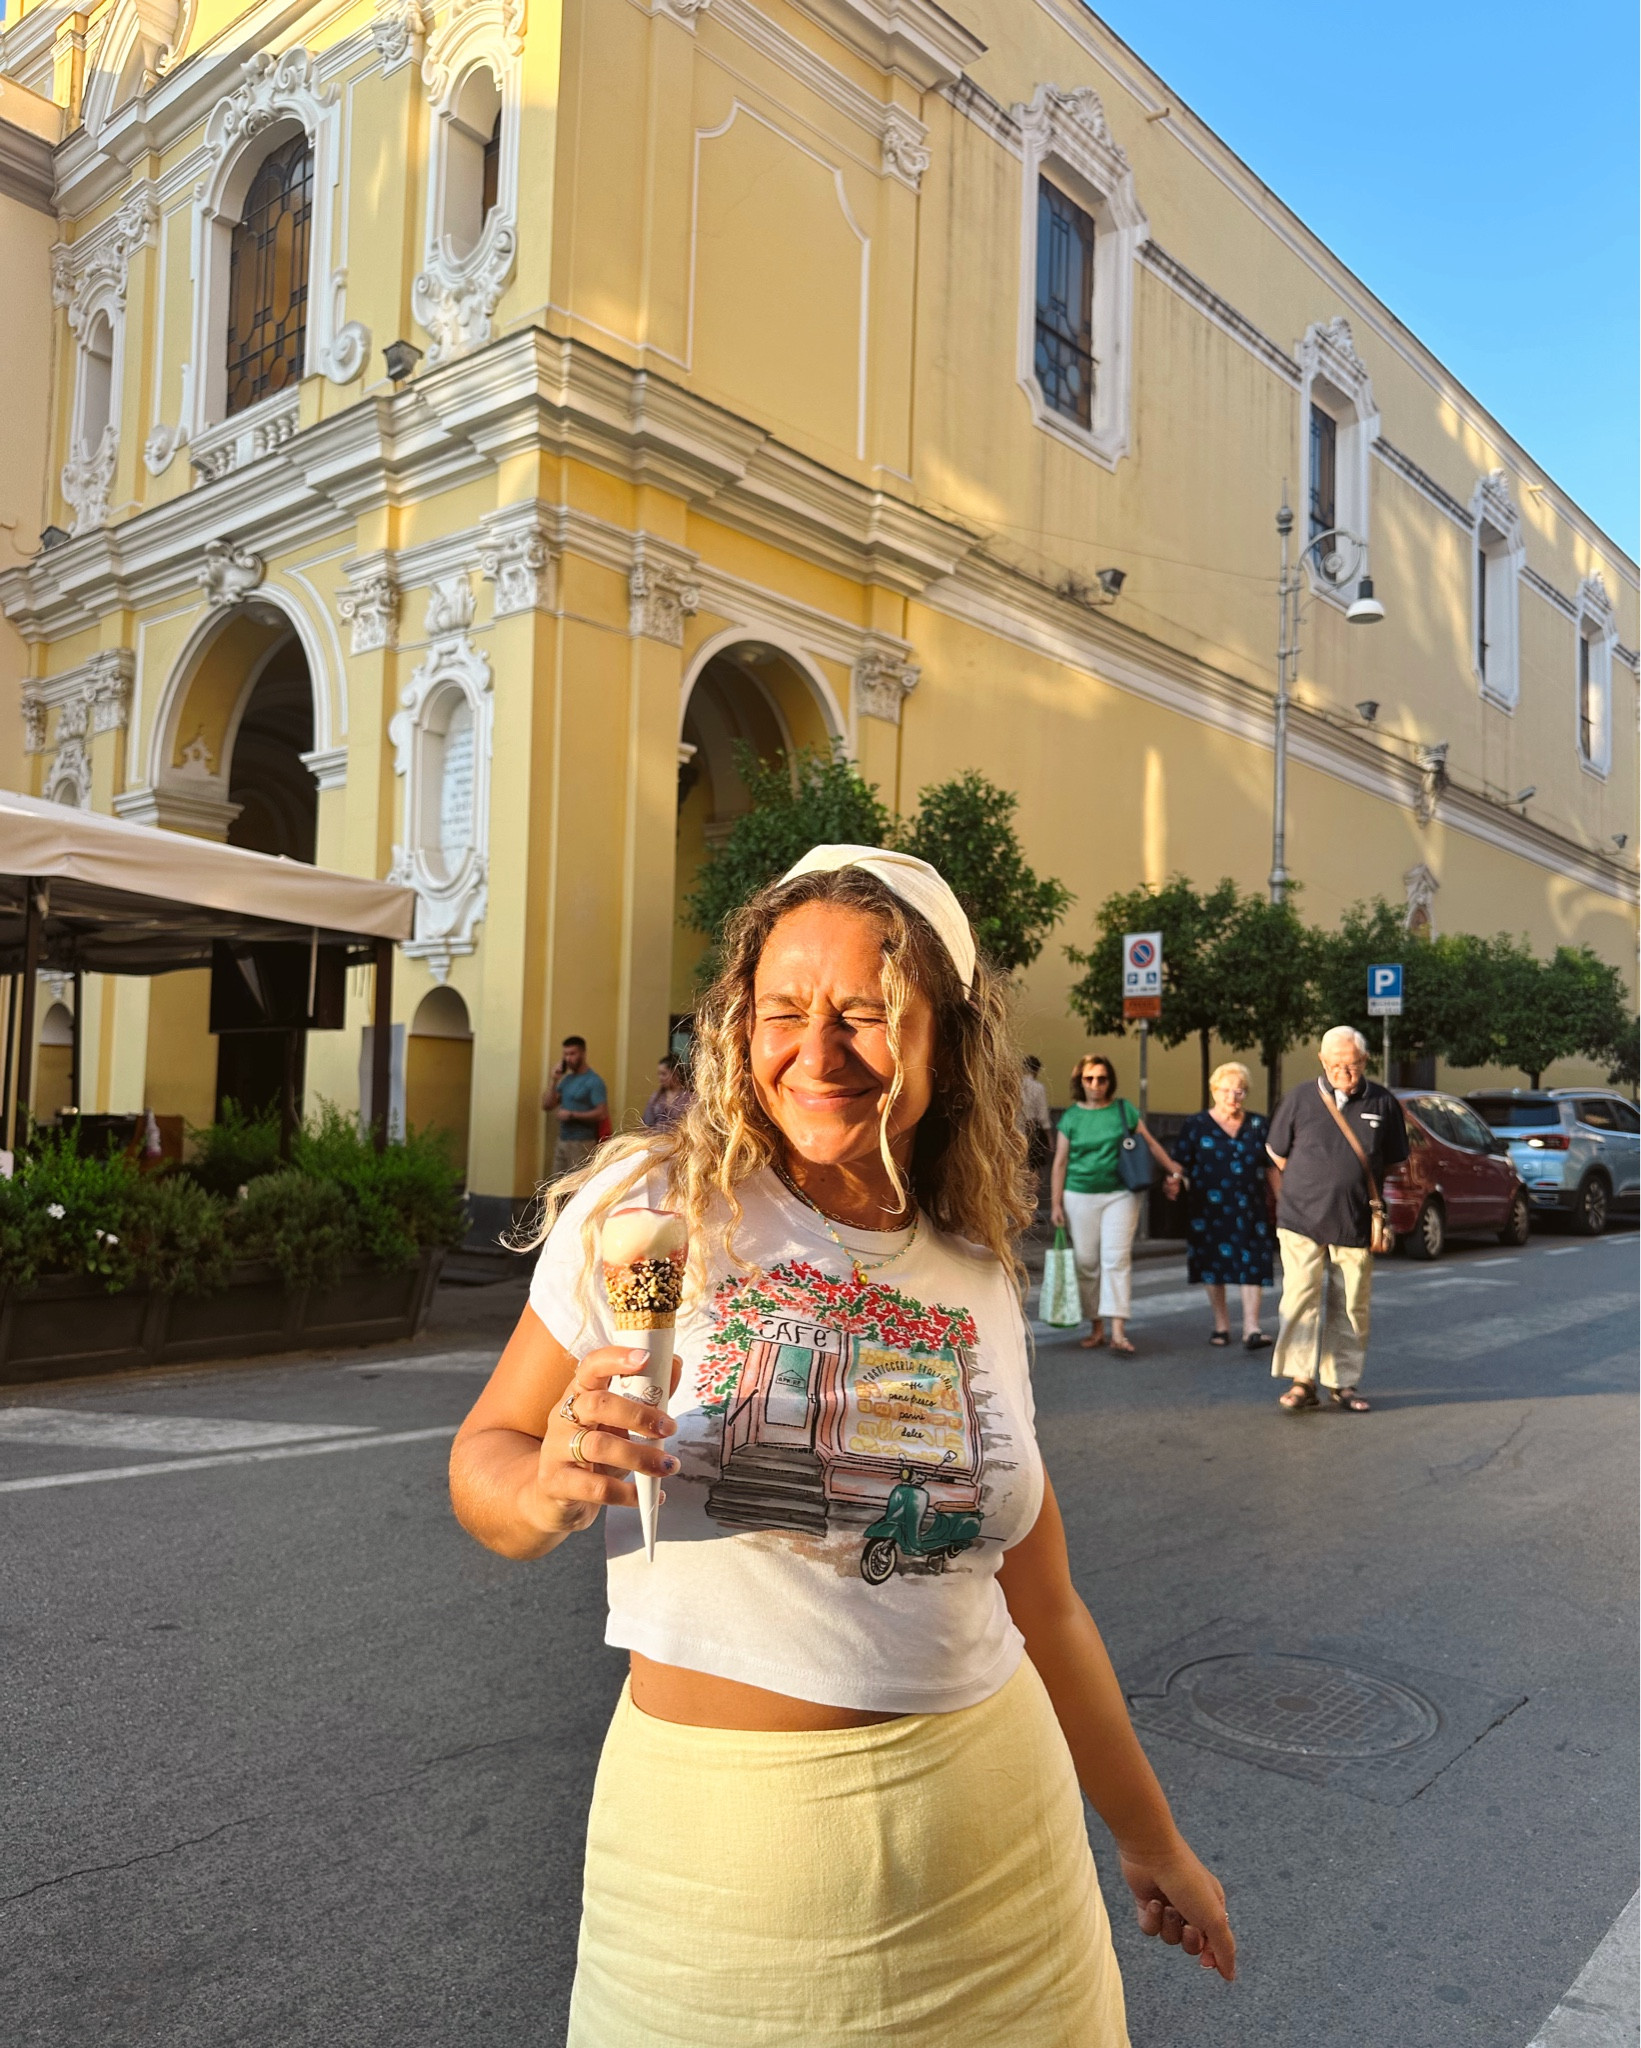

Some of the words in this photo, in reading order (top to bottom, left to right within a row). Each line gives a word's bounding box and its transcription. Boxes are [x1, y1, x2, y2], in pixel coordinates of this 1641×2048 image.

[1375, 969, 1395, 995] P
[862, 1360, 915, 1383] PASTICCERIA
[918, 1363, 953, 1391] ITALIANA
[888, 1393, 910, 1402] pane
[910, 1394, 937, 1407] fresco
[898, 1411, 925, 1422] panini
[901, 1427, 925, 1439] dolce
